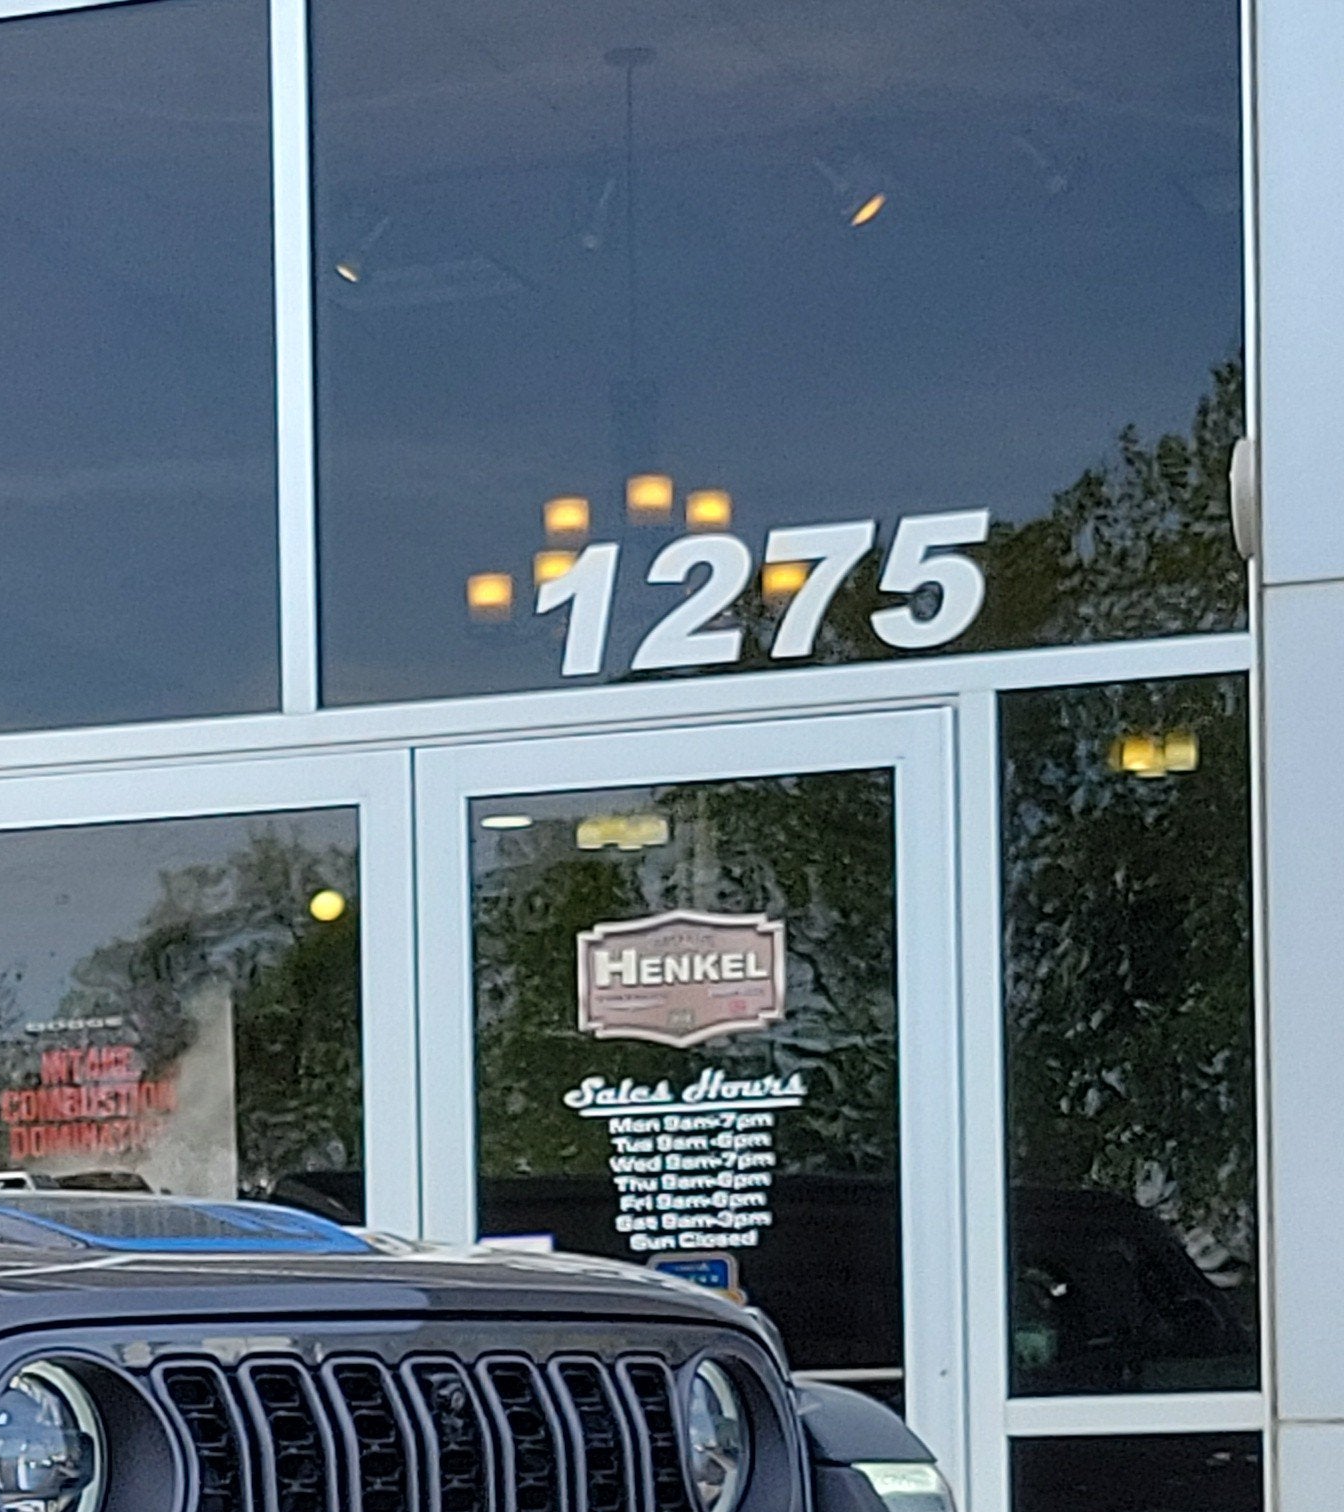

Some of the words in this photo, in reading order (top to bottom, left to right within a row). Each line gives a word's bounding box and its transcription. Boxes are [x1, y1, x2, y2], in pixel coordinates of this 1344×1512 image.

[535, 508, 990, 676] 1275
[593, 949, 769, 987] HENKEL
[563, 1076, 674, 1108] Sales
[682, 1067, 807, 1103] Hours
[609, 1117, 660, 1133] Mon
[609, 1156, 661, 1172] Wed
[614, 1176, 658, 1191] Thu
[620, 1195, 653, 1211] Fri
[616, 1215, 658, 1232] Sat
[630, 1234, 676, 1250] Sun
[678, 1230, 758, 1248] Closed
